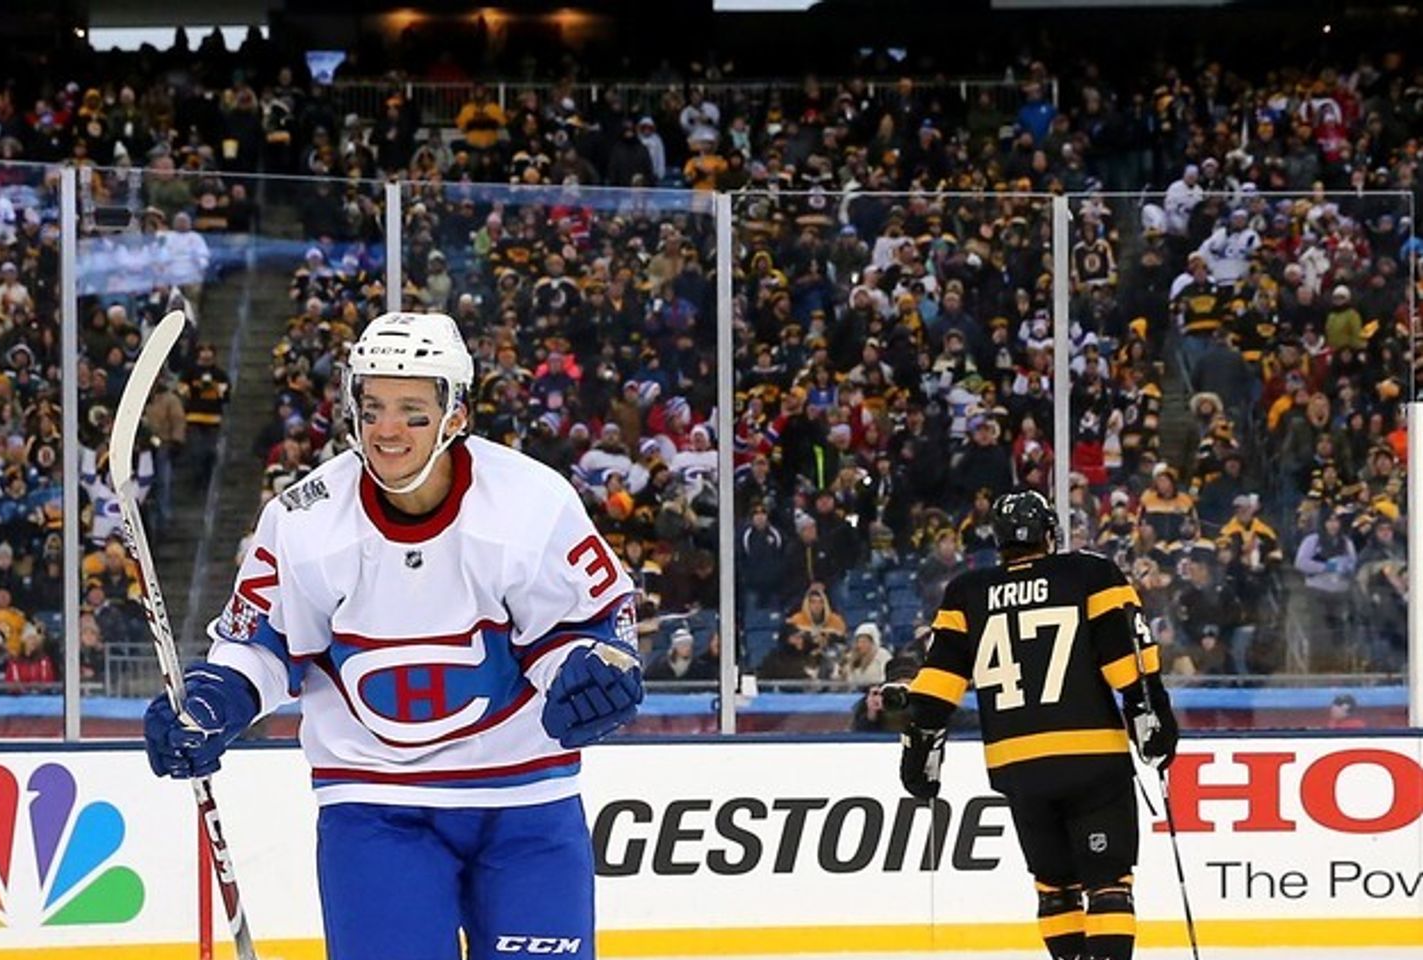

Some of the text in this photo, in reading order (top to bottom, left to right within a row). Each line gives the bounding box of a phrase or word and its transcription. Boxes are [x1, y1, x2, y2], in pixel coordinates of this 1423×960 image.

[988, 578, 1049, 610] KRUG
[973, 605, 1080, 711] 47
[1152, 748, 1423, 834] HO
[1206, 862, 1308, 900] The
[496, 936, 582, 954] CCM
